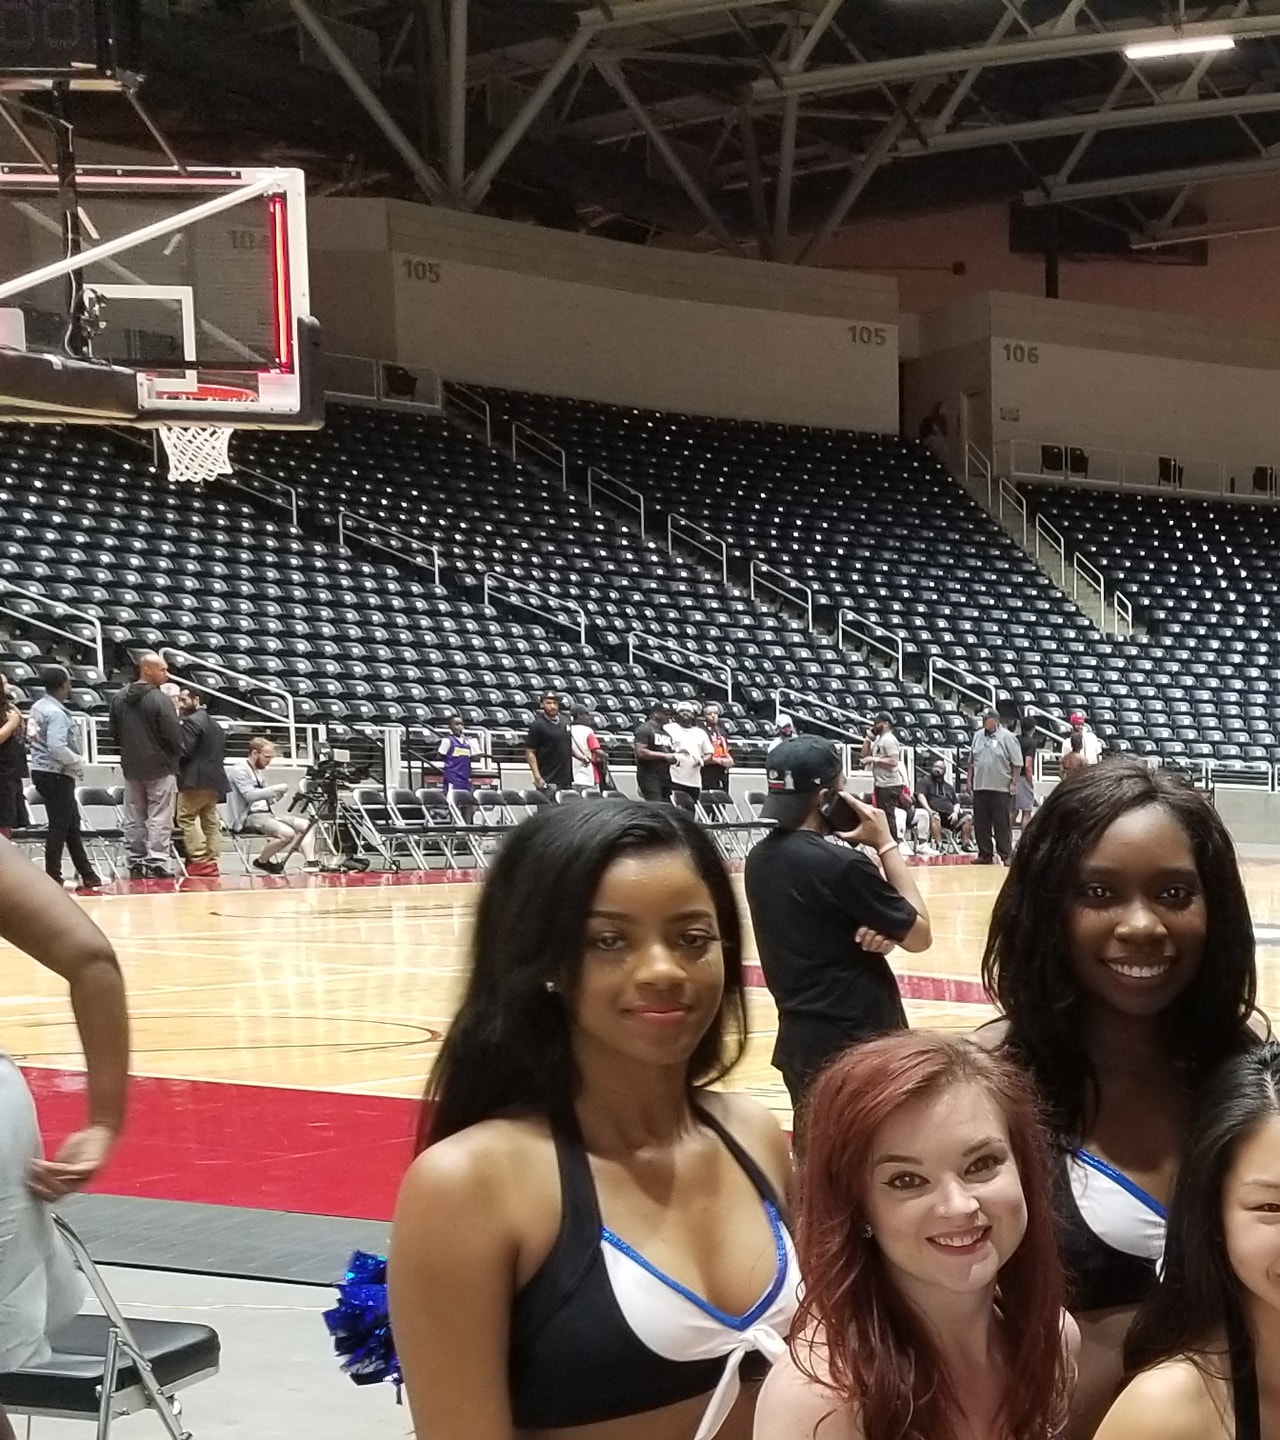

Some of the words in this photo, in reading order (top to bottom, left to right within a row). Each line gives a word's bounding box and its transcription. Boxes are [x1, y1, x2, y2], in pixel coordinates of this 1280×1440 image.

[402, 259, 441, 283] 105
[848, 325, 887, 346] 105
[1003, 343, 1039, 364] 106
